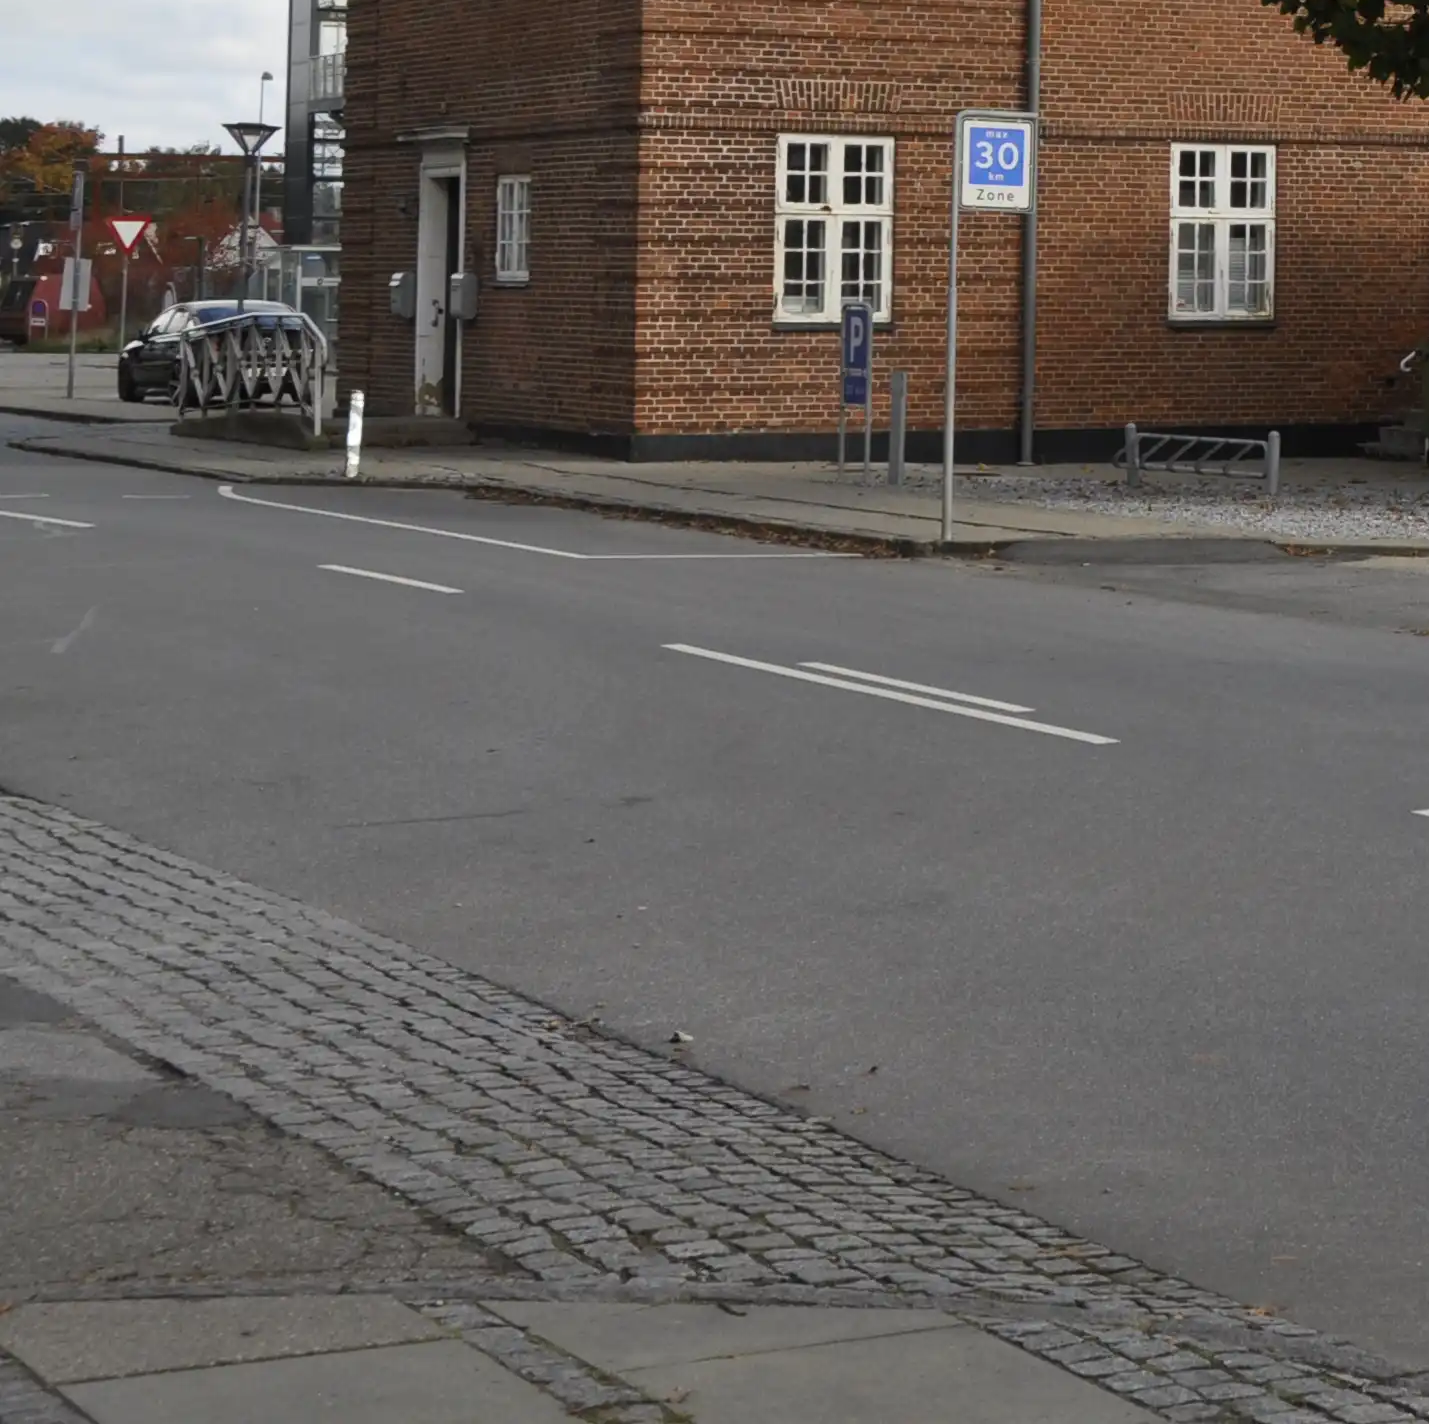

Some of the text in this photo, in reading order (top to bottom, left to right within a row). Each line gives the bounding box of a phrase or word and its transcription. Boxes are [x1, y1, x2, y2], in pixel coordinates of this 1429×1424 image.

[985, 130, 1009, 139] max
[975, 140, 1020, 171] 30
[988, 172, 1005, 182] km
[975, 188, 1016, 203] Zone
[849, 316, 864, 364] P
